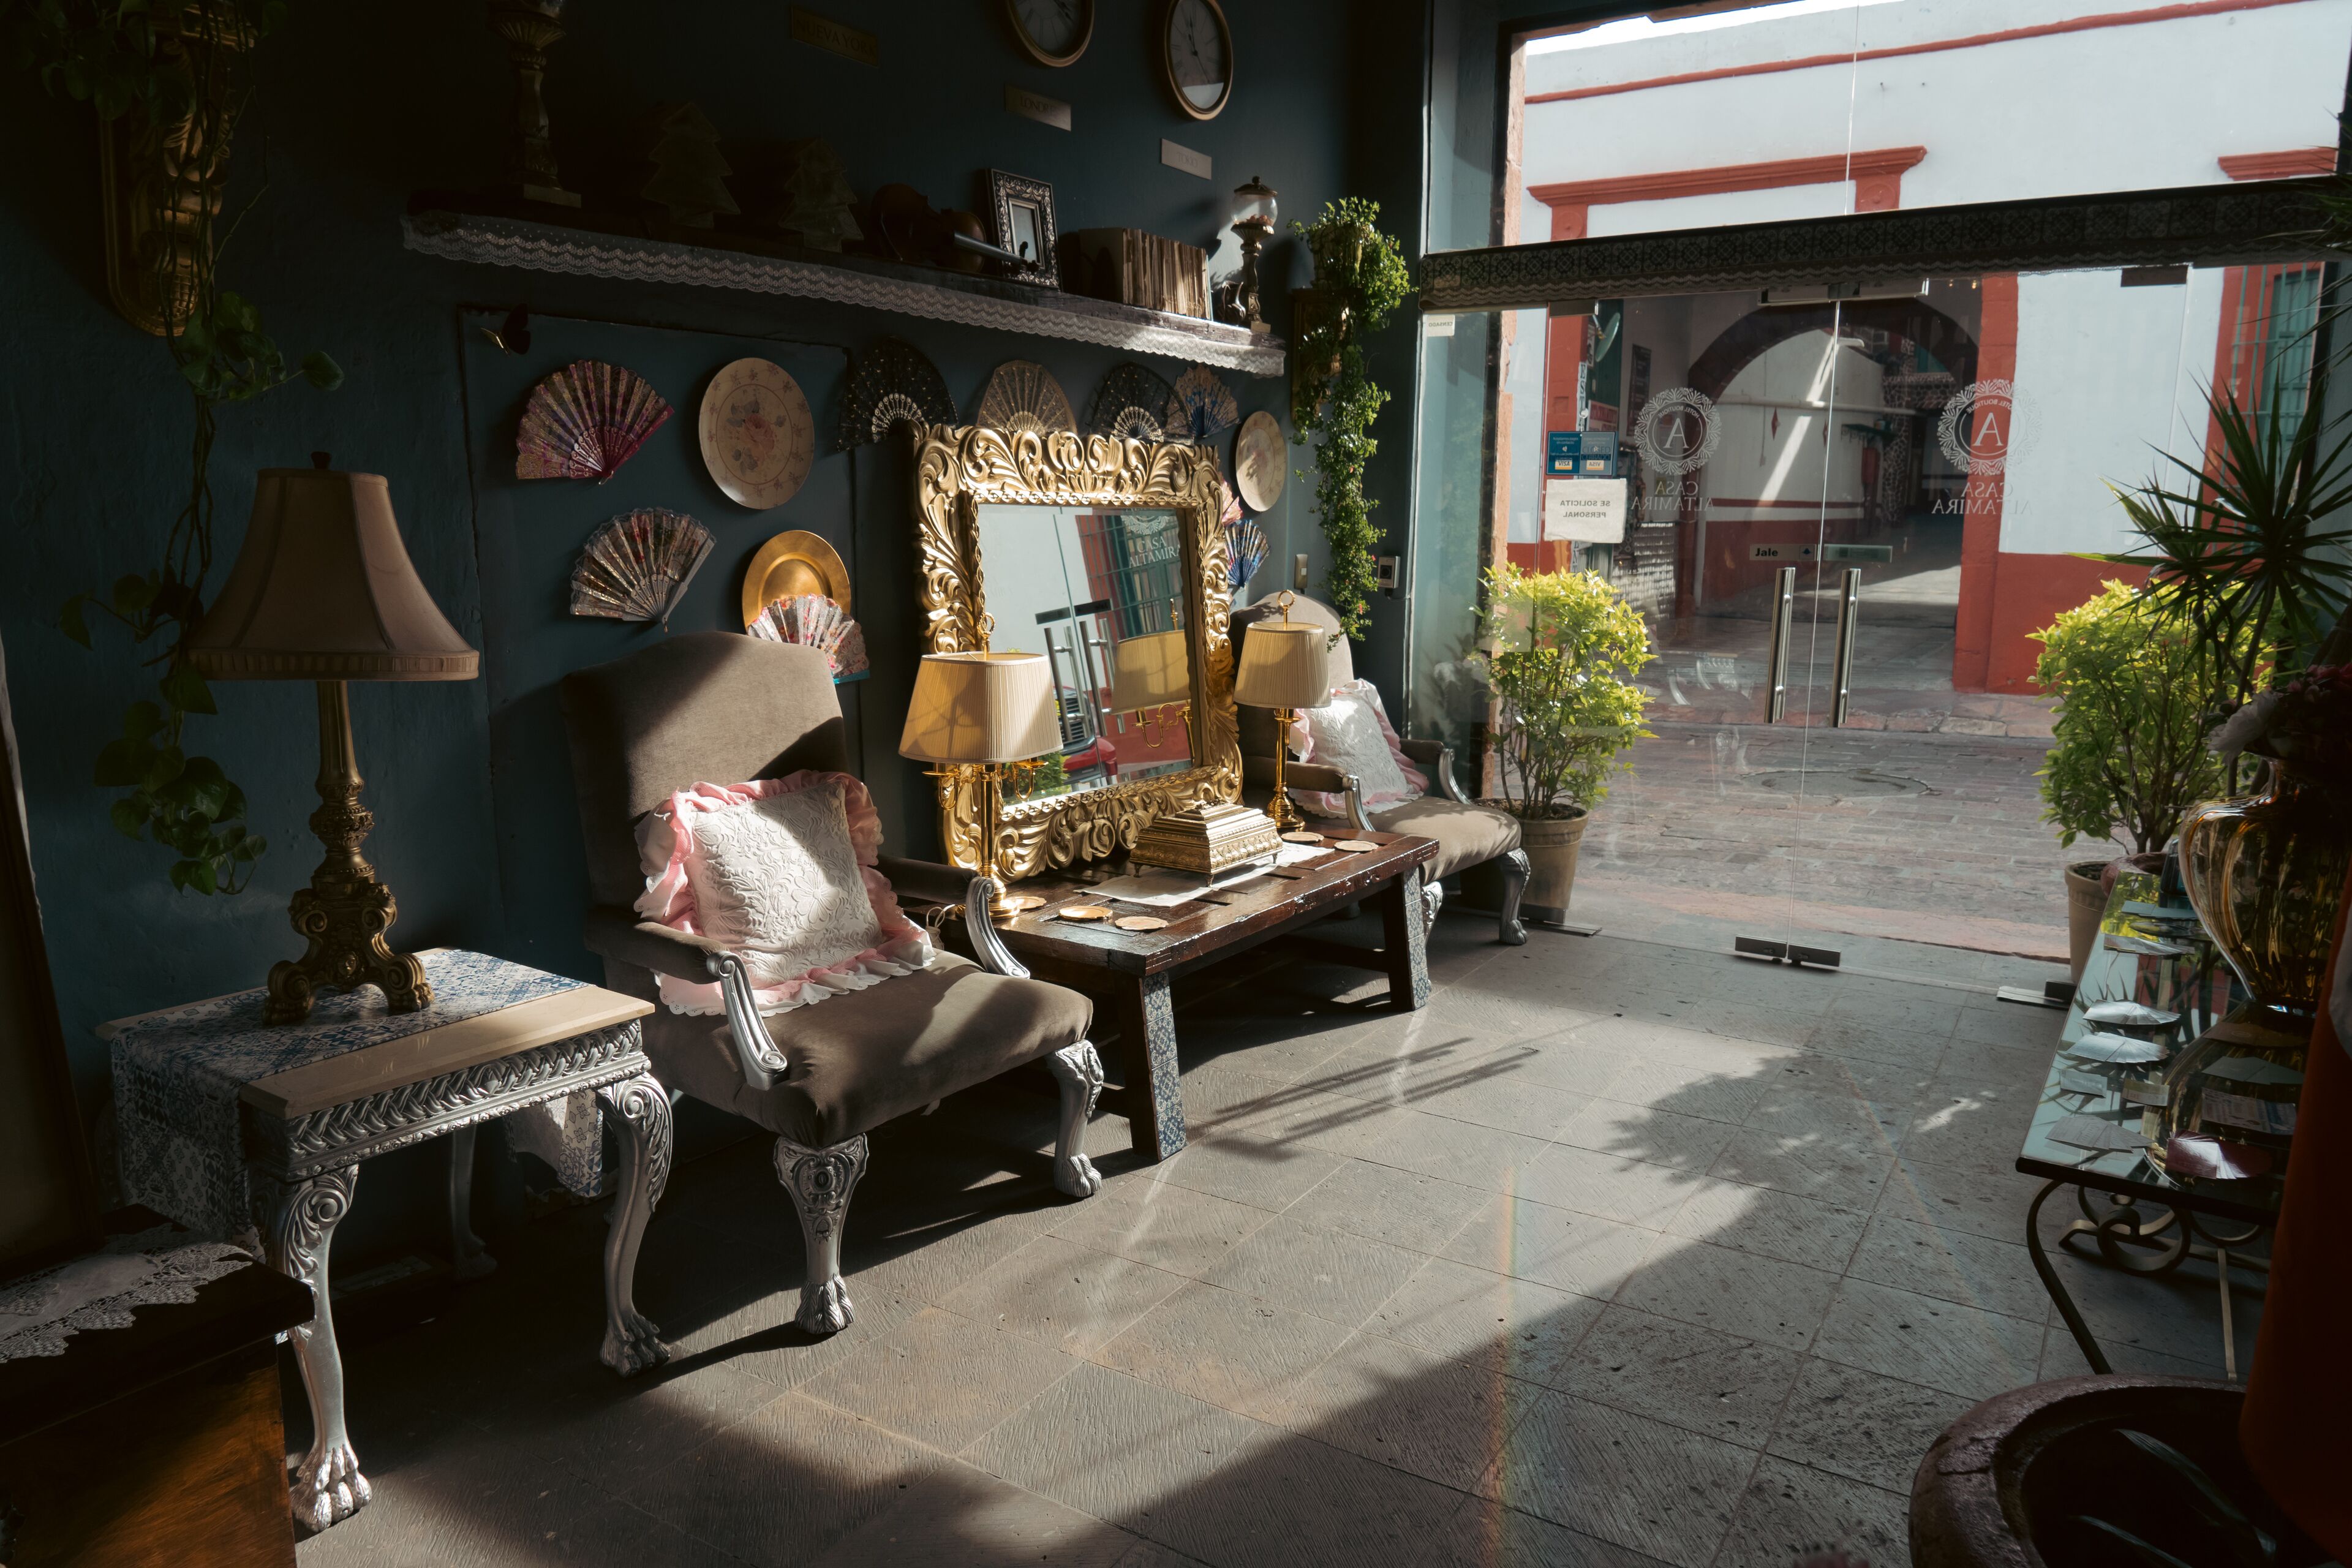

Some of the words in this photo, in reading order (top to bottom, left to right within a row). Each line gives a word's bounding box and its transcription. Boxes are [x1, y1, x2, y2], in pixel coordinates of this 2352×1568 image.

[796, 19, 840, 46] NUEVA
[842, 34, 878, 58] YORK
[1137, 536, 1166, 552] CASA
[1755, 548, 1779, 557] Jale
